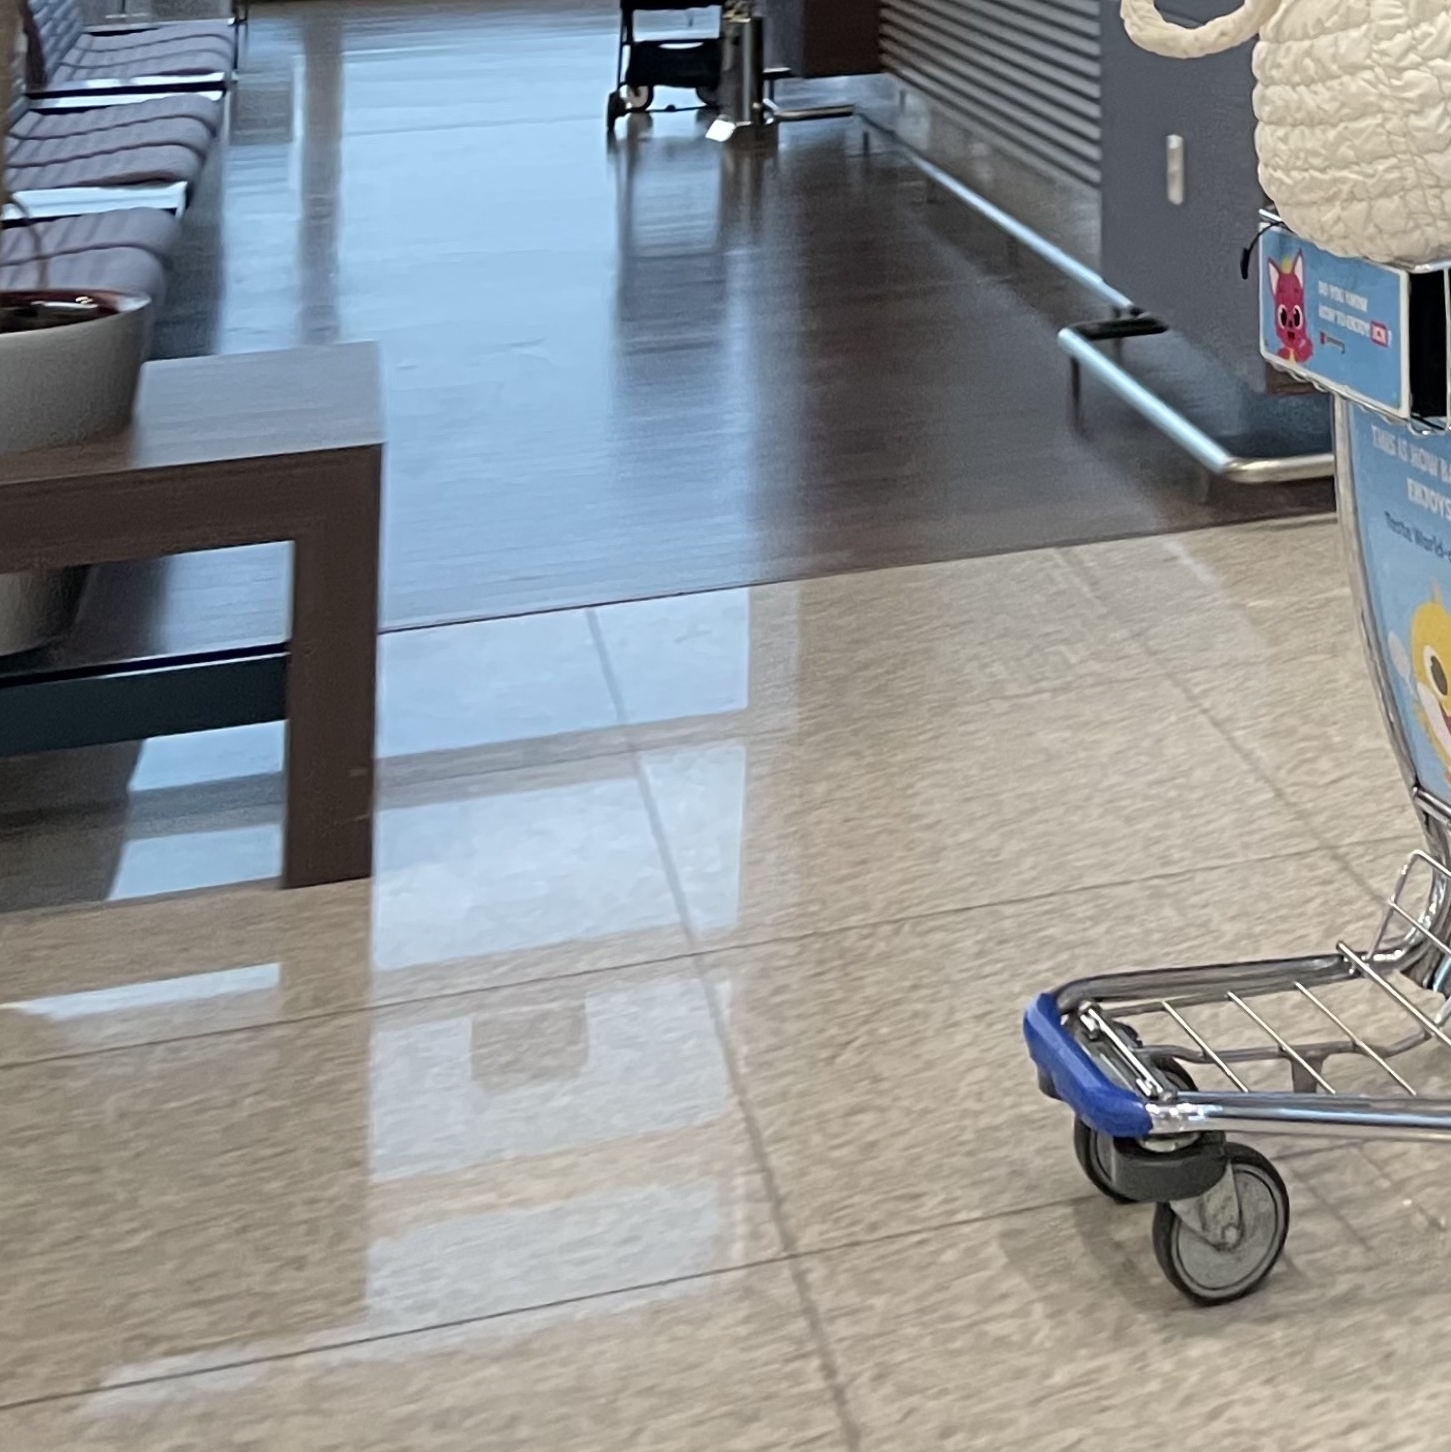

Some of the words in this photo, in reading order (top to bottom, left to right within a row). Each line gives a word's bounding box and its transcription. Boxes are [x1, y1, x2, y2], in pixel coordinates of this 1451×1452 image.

[1370, 424, 1397, 457] THIS
[1397, 436, 1409, 463] IS
[1409, 443, 1439, 478] HOW
